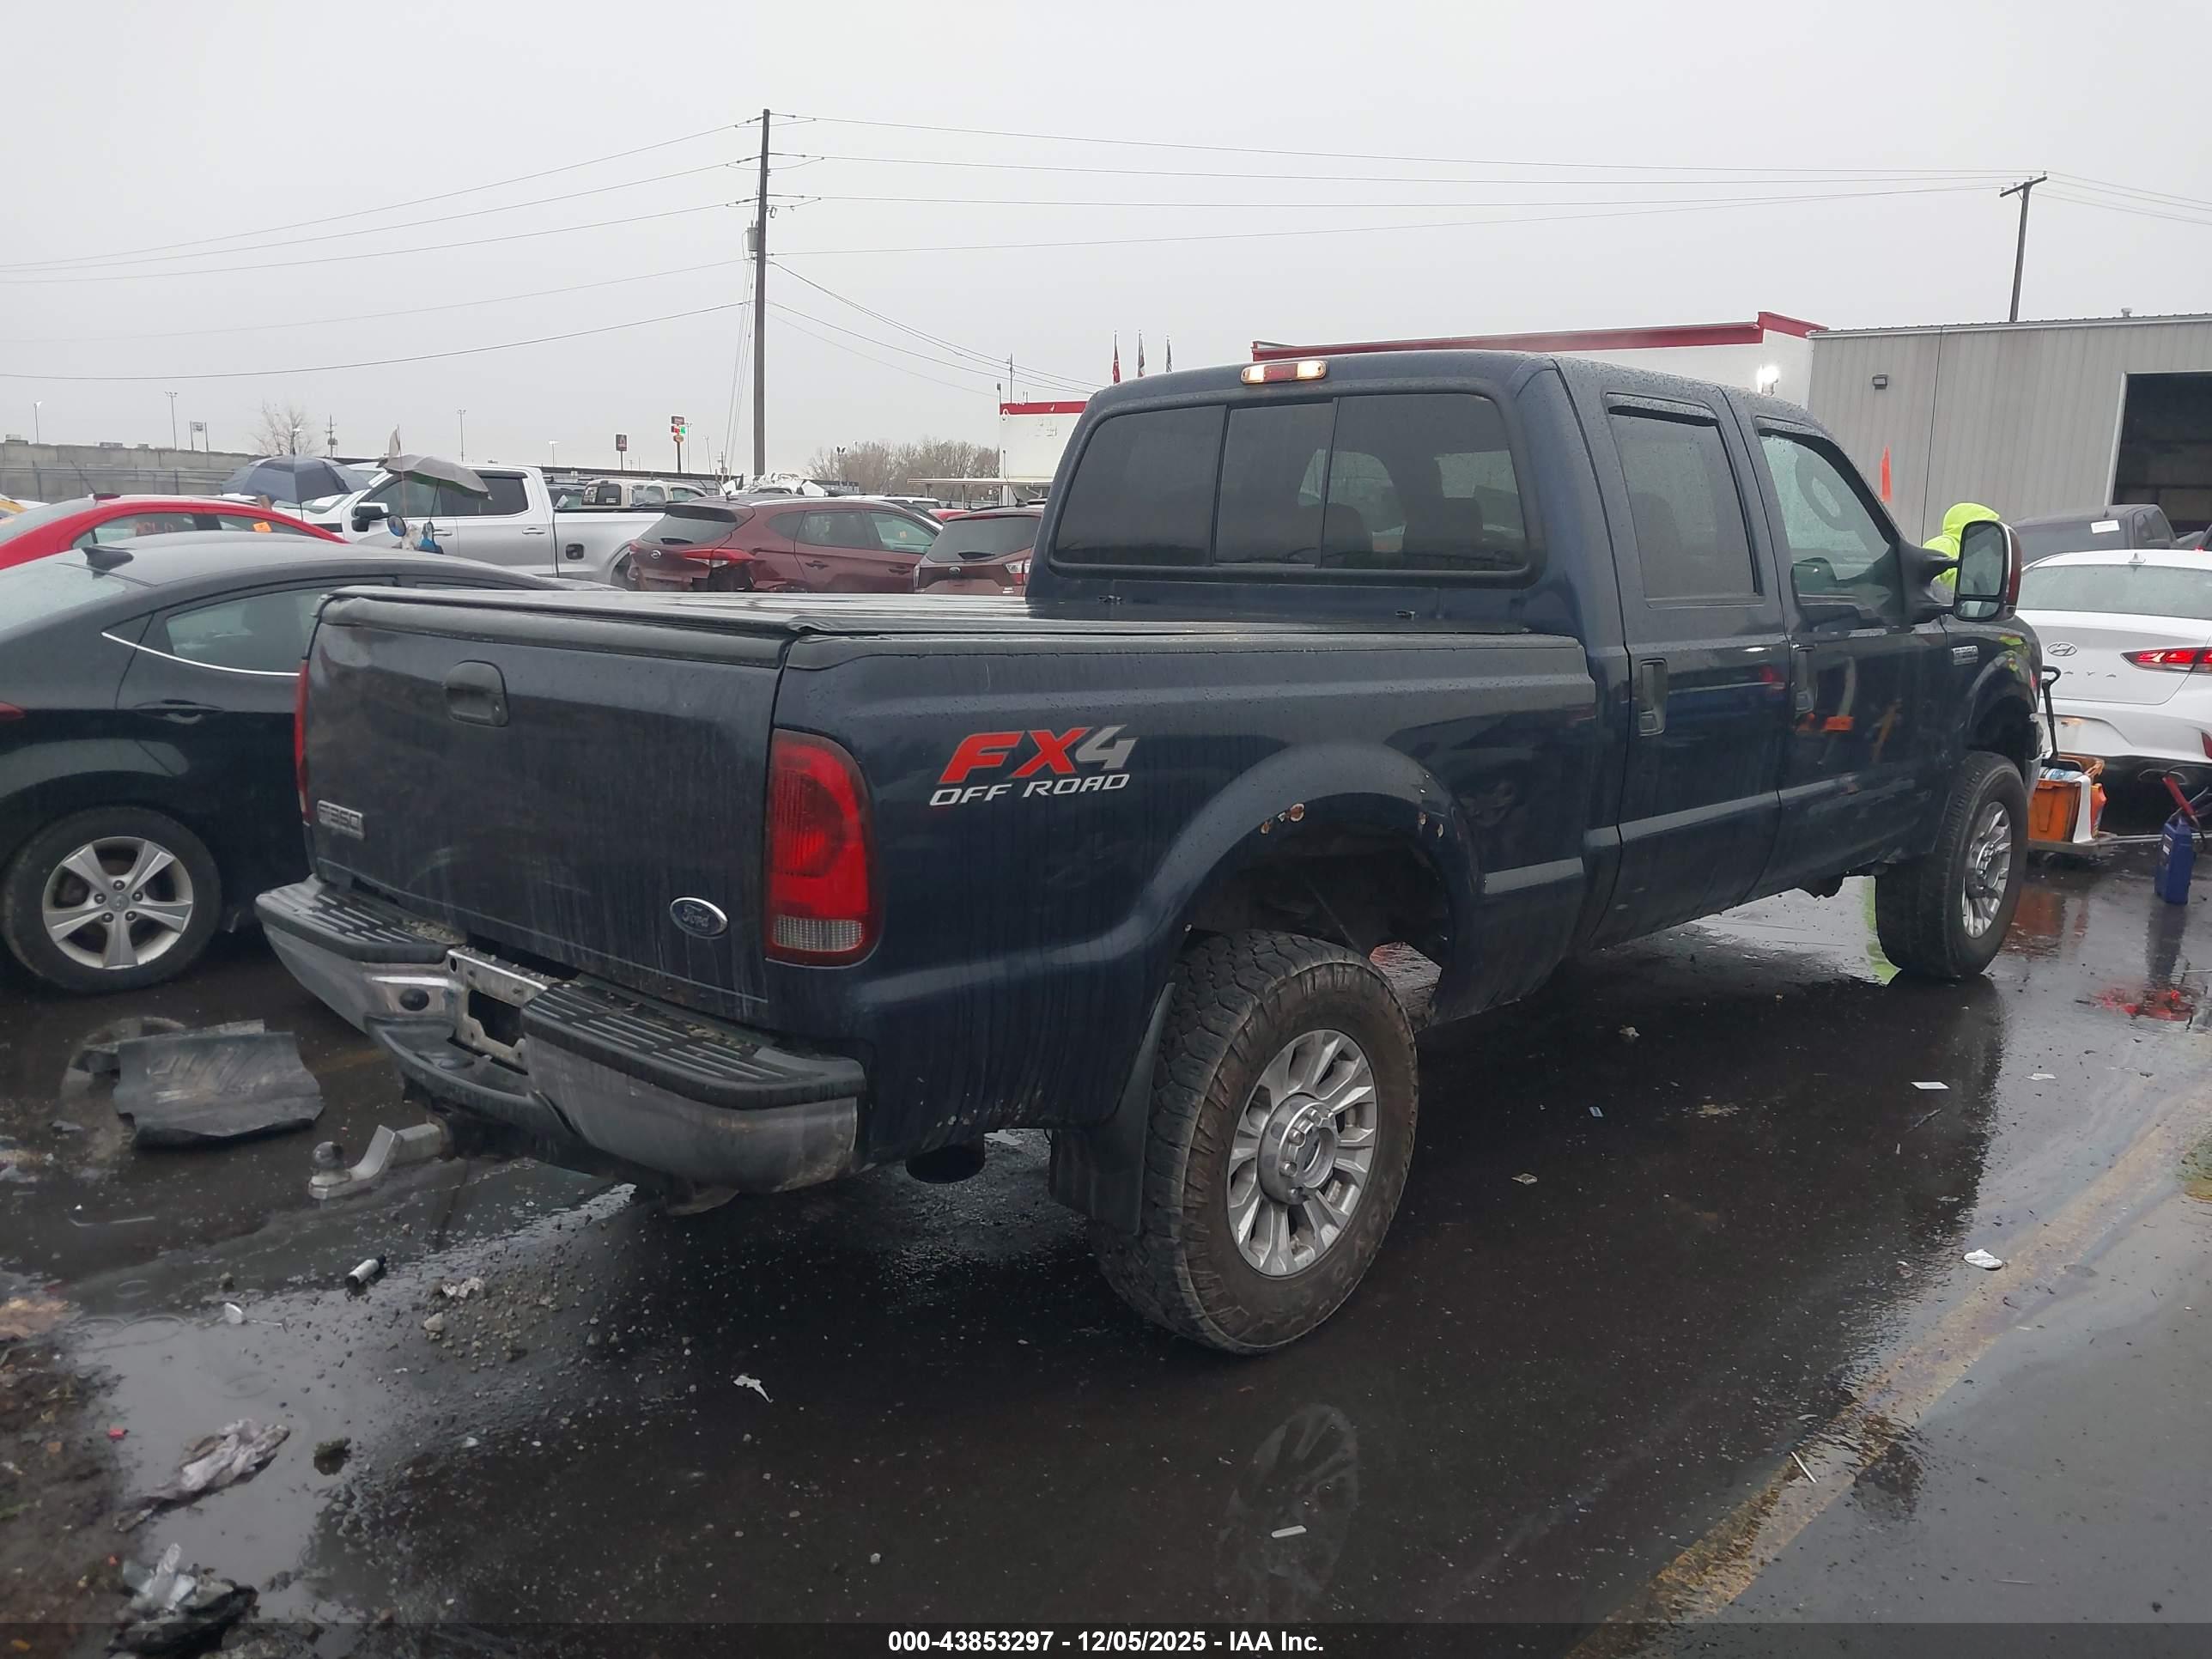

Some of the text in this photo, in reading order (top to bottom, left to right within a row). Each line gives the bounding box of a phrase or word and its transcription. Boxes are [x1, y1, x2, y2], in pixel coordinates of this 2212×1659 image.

[939, 725, 1139, 784] FX4
[929, 773, 1131, 806] OFF ROAD
